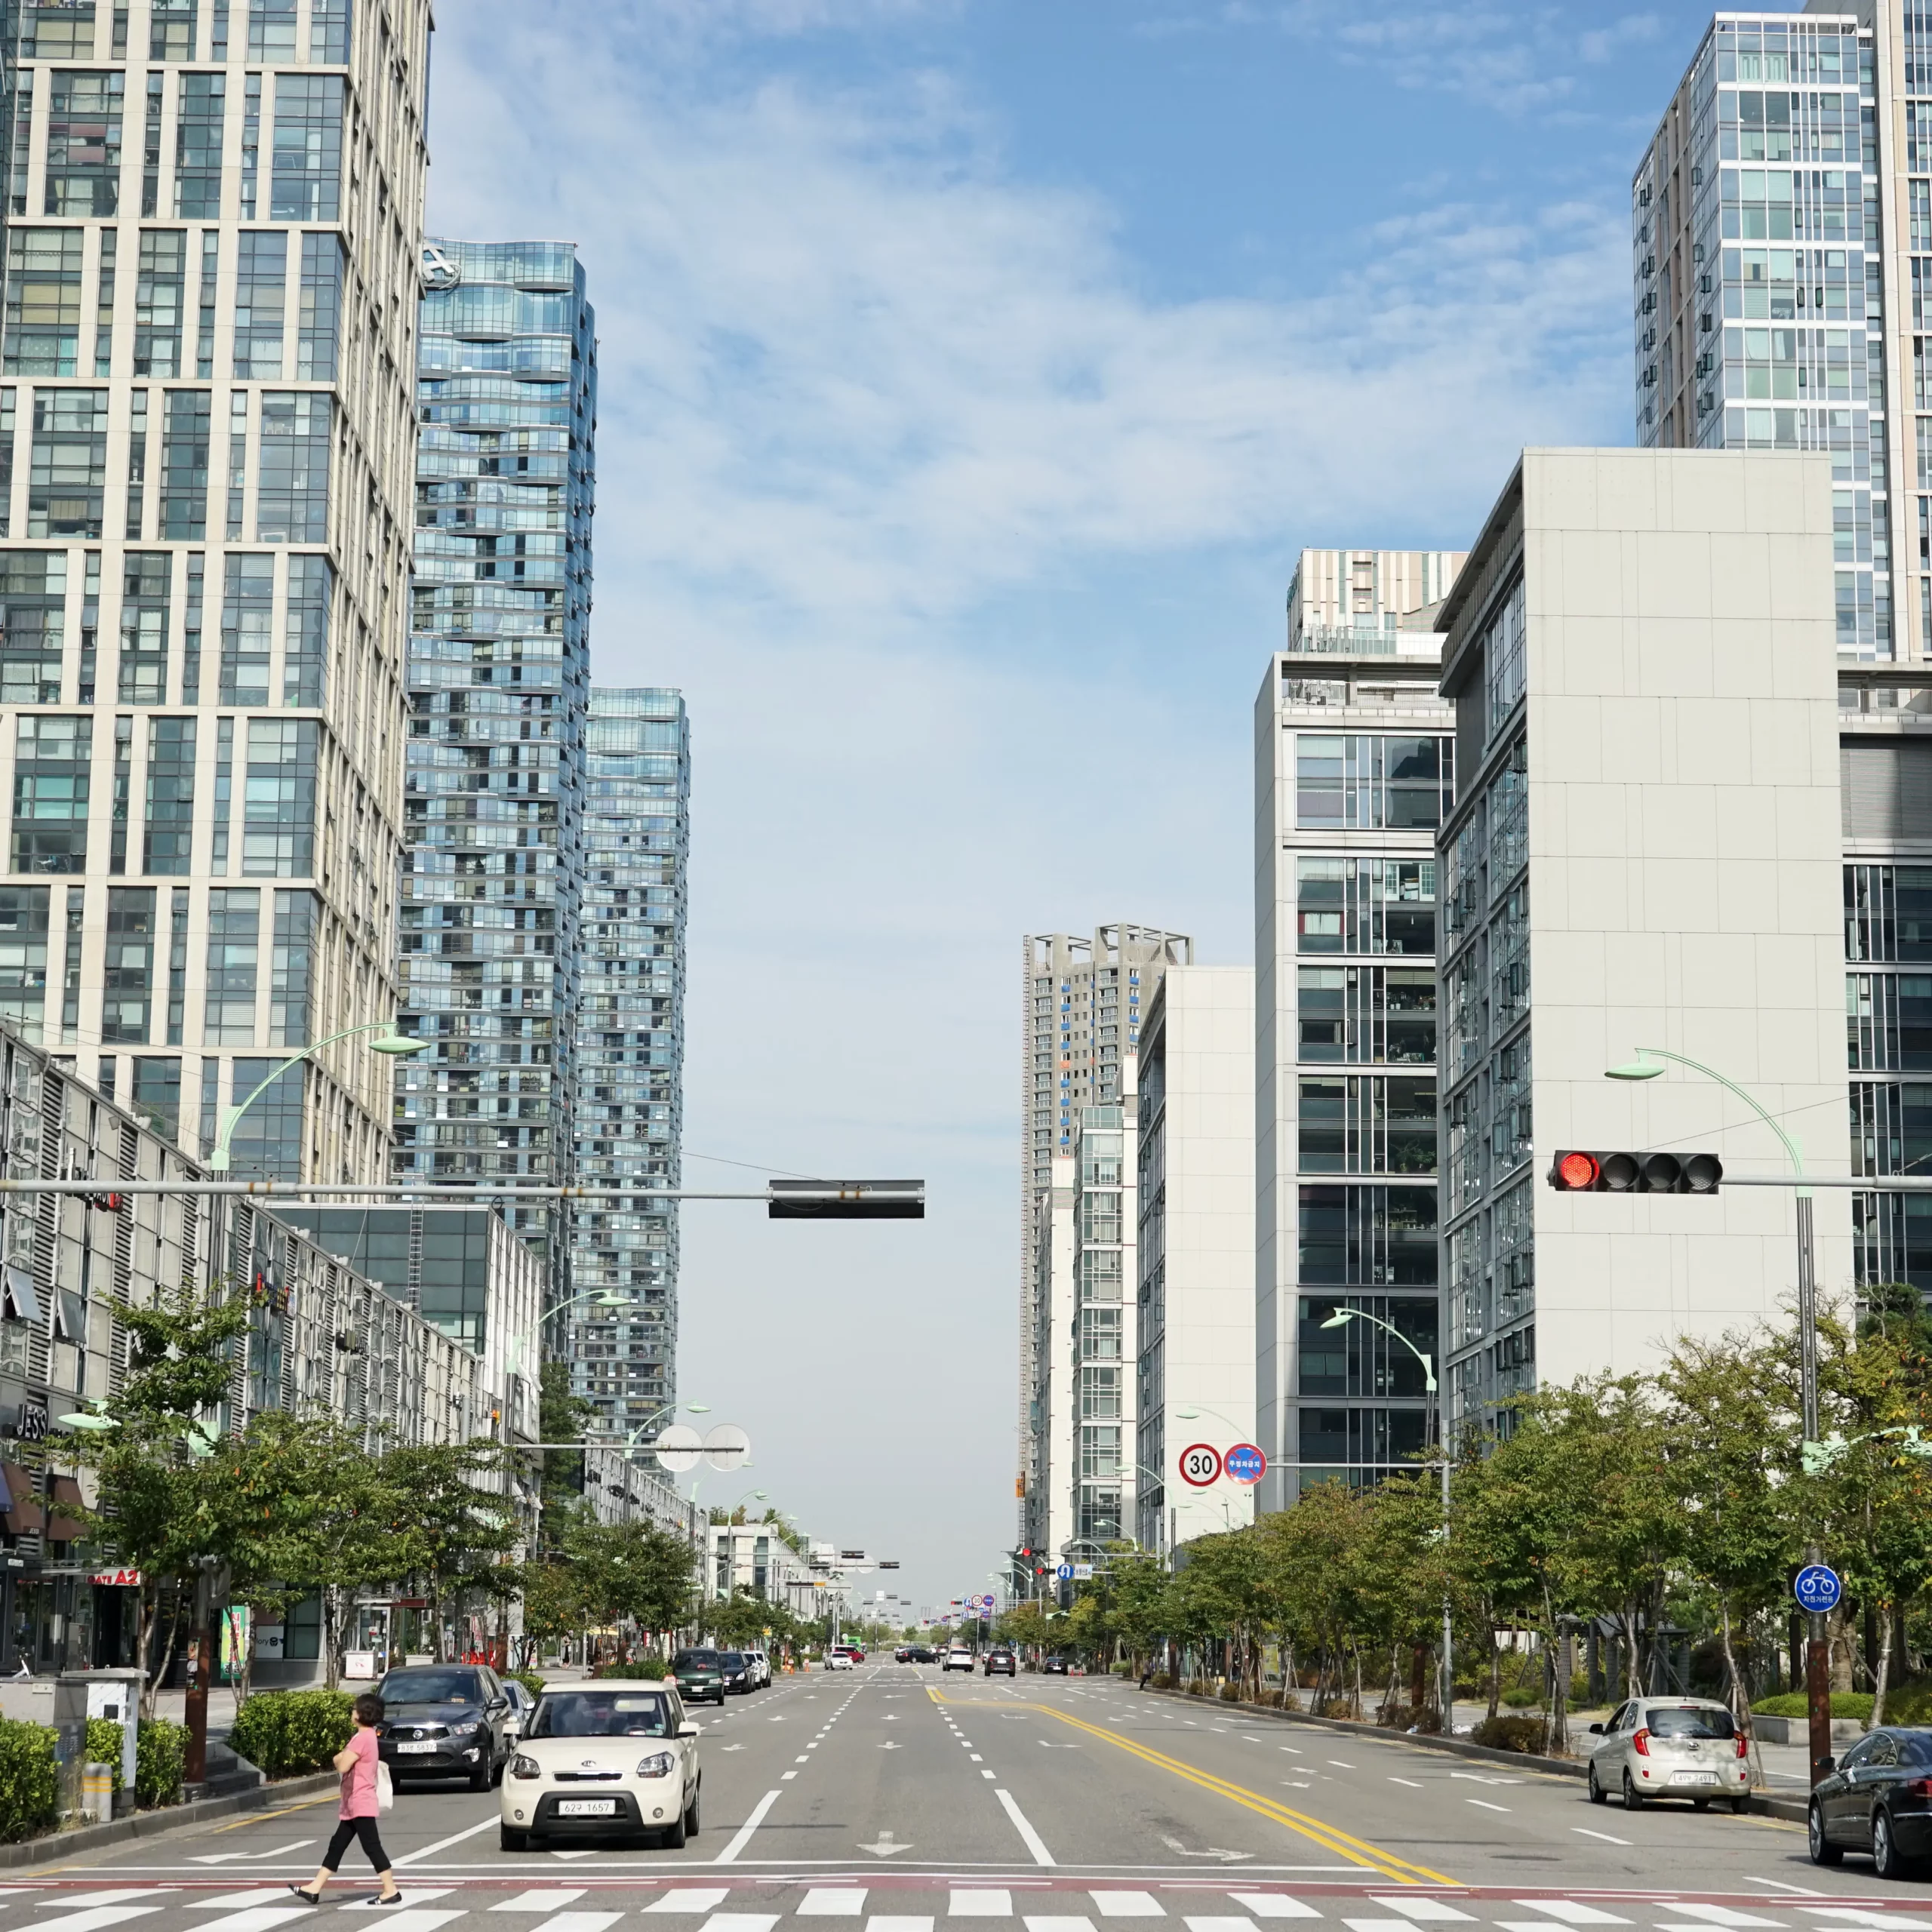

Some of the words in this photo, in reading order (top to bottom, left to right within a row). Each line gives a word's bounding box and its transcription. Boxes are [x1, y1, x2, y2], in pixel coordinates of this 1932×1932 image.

[1190, 1455, 1212, 1475] 30
[1229, 1460, 1260, 1468] 주정차금지
[115, 1570, 138, 1585] A2
[1803, 1595, 1834, 1604] 자전거전용
[587, 1803, 610, 1812] 1657
